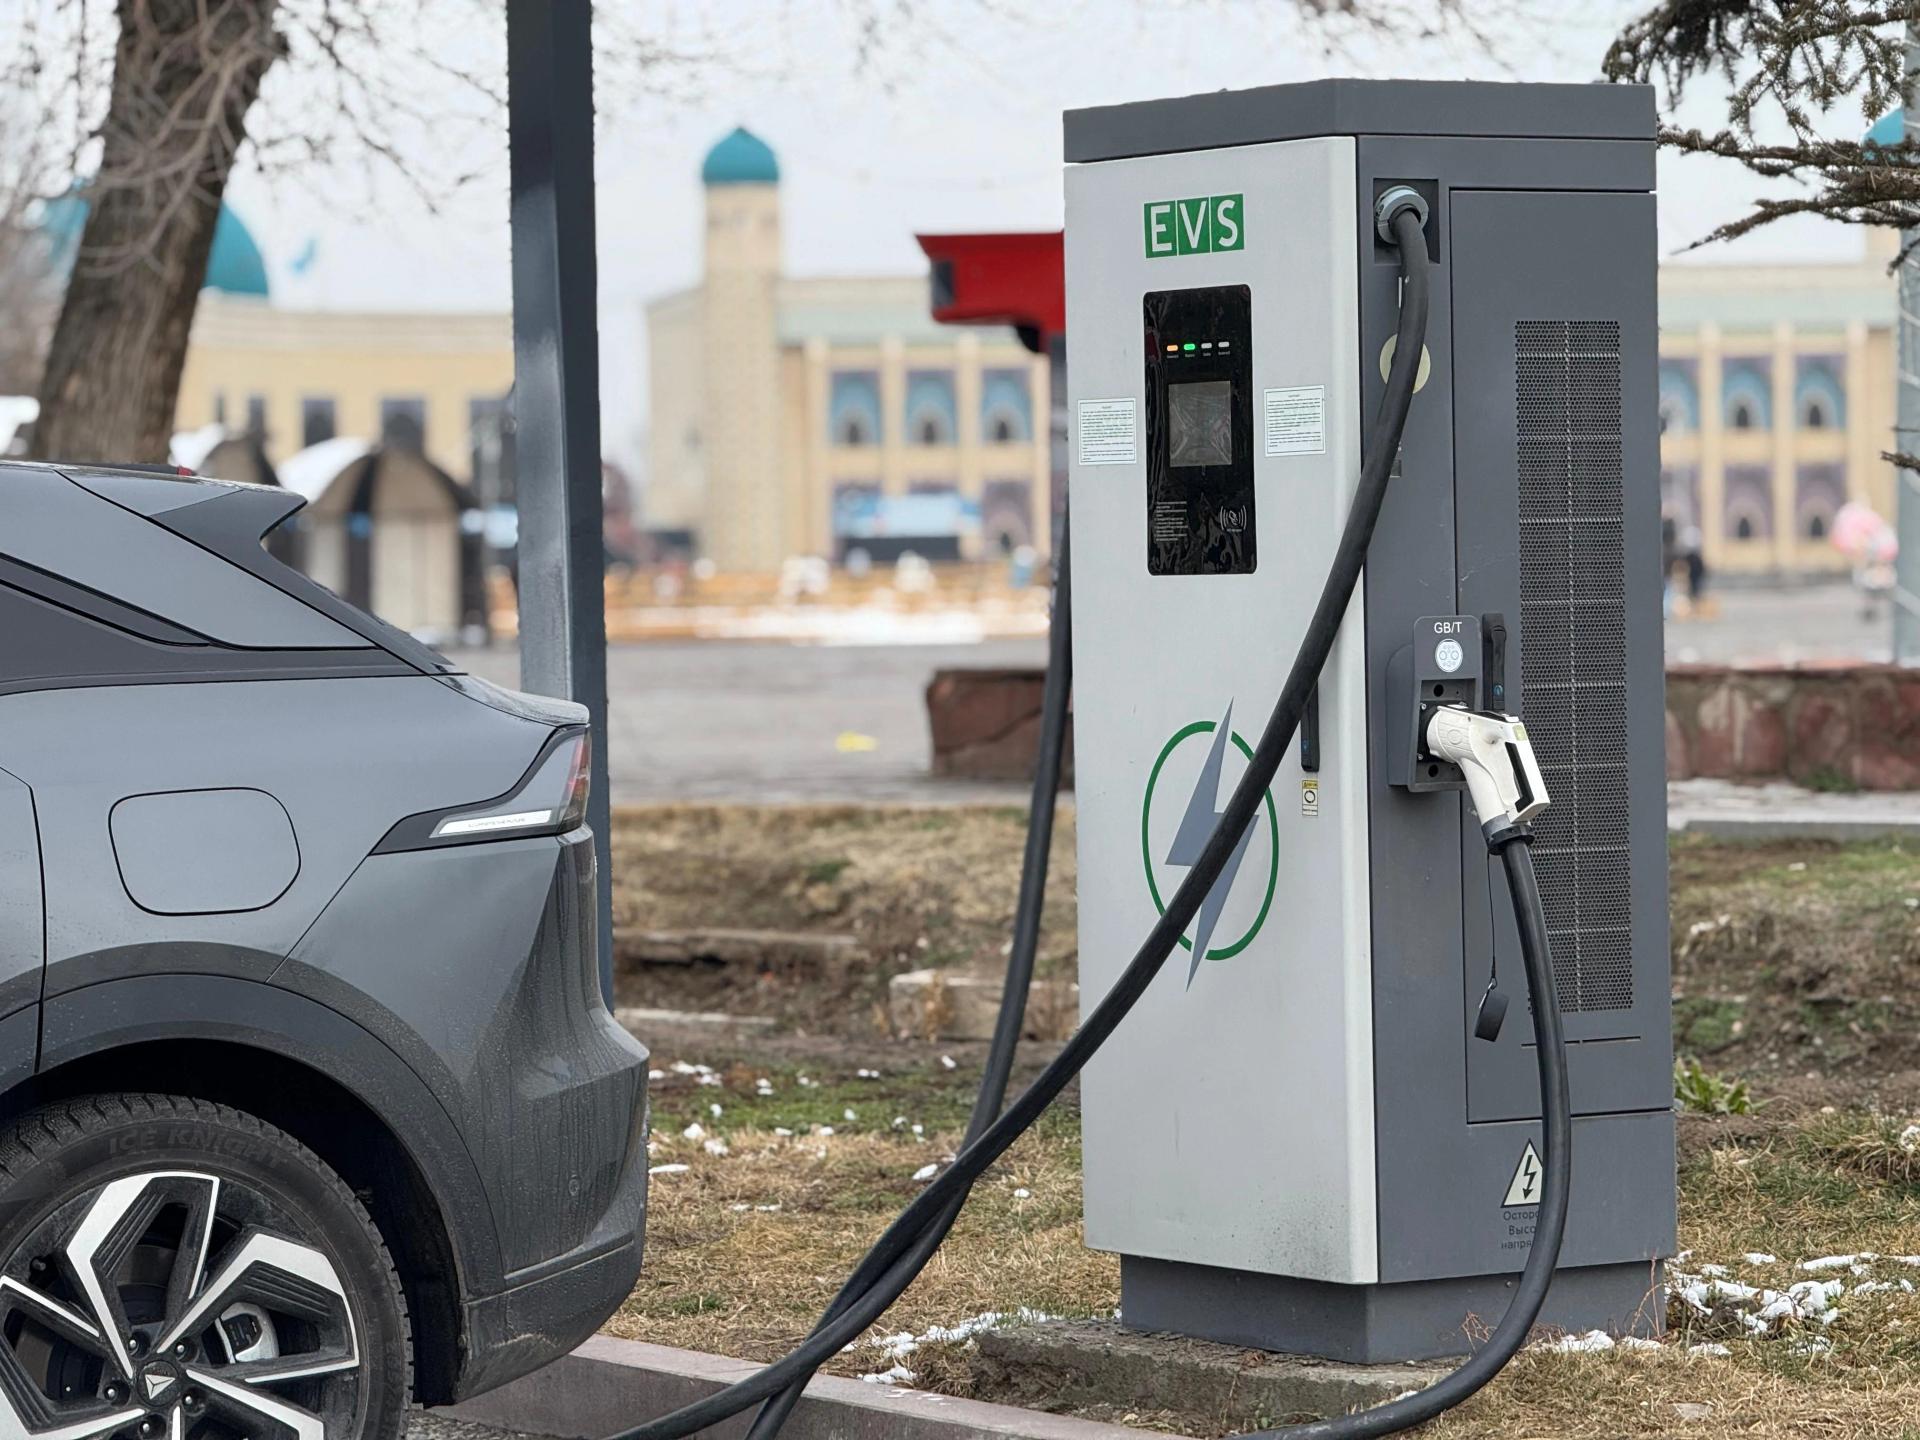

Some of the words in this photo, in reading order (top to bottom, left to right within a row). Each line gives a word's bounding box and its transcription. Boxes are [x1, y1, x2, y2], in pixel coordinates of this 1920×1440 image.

[1150, 199, 1237, 252] EVS
[1433, 621, 1463, 634] GB/T
[109, 1126, 158, 1155] ICE
